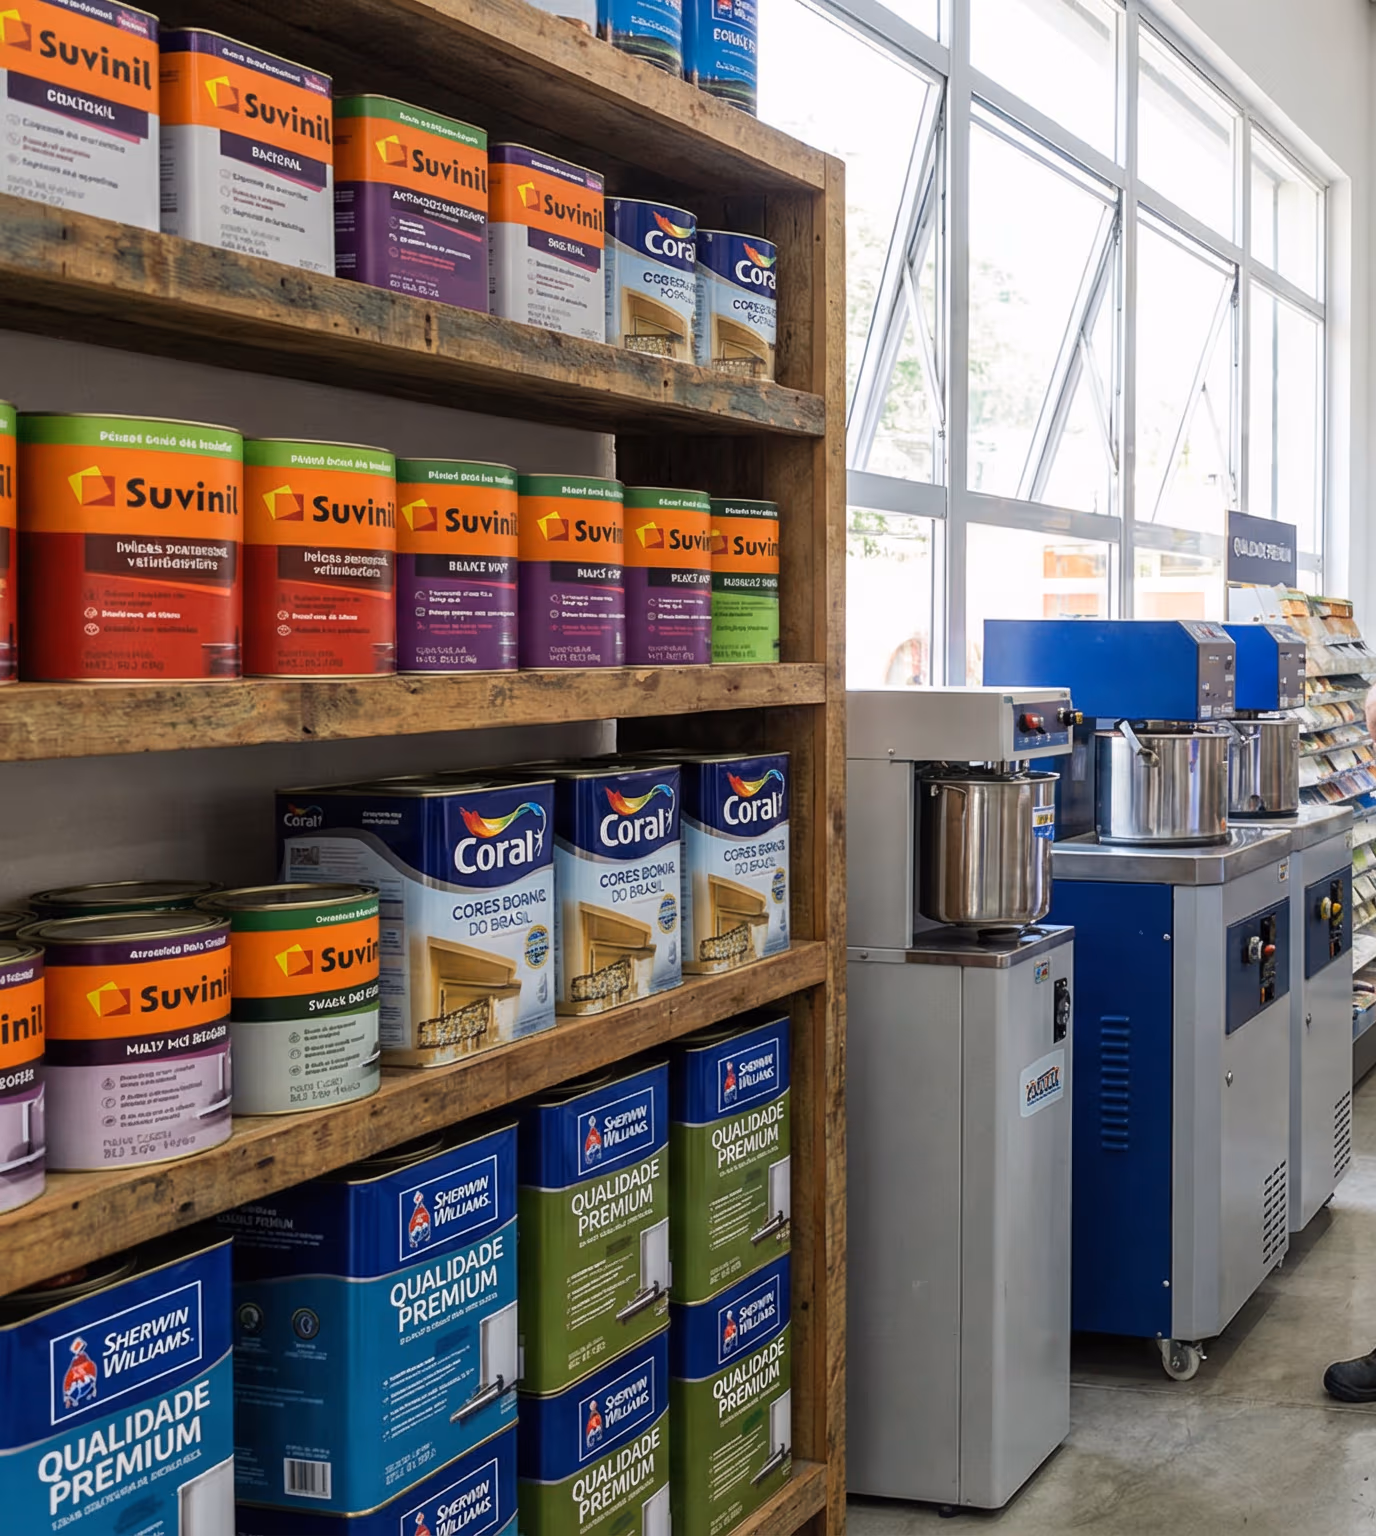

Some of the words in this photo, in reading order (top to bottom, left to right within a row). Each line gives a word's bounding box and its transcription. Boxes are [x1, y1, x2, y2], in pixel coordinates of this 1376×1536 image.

[40, 30, 151, 90] Suvinil
[245, 93, 331, 144] Suvinil
[412, 149, 487, 194] Suvinil
[544, 194, 602, 232] Suvinil
[644, 230, 696, 263] Cora
[735, 260, 776, 290] Cora
[126, 478, 238, 515] Suvinil
[313, 495, 395, 529] Suvinil
[284, 813, 317, 828] Coral
[600, 808, 664, 847] Coral
[723, 791, 777, 826] Coral
[454, 829, 534, 874] Coral
[600, 868, 640, 888] CORES
[612, 886, 626, 903] DO
[452, 898, 500, 921] CORES
[469, 919, 488, 936] DO
[321, 937, 379, 973] Suvin
[0, 1004, 43, 1044] inil
[712, 1101, 784, 1150] QUALIDADE
[718, 1123, 779, 1169] PREMIUM
[433, 1175, 489, 1210] SHERWIN
[571, 1158, 660, 1216] QUALIDADE
[578, 1183, 653, 1237] PREMIUM
[390, 1236, 504, 1308] QUALIDADE
[399, 1265, 497, 1333] PREMIUM
[102, 1306, 189, 1356] SHERWIN
[103, 1327, 195, 1379] WILLIAMS.
[713, 1336, 785, 1399] QUALIDADE
[719, 1360, 780, 1419] PREMIUM
[37, 1379, 211, 1483] QUALIDADE
[50, 1415, 202, 1516] PREMIUM
[572, 1427, 661, 1502] QUALIDADE
[579, 1453, 654, 1524] PREMIUM
